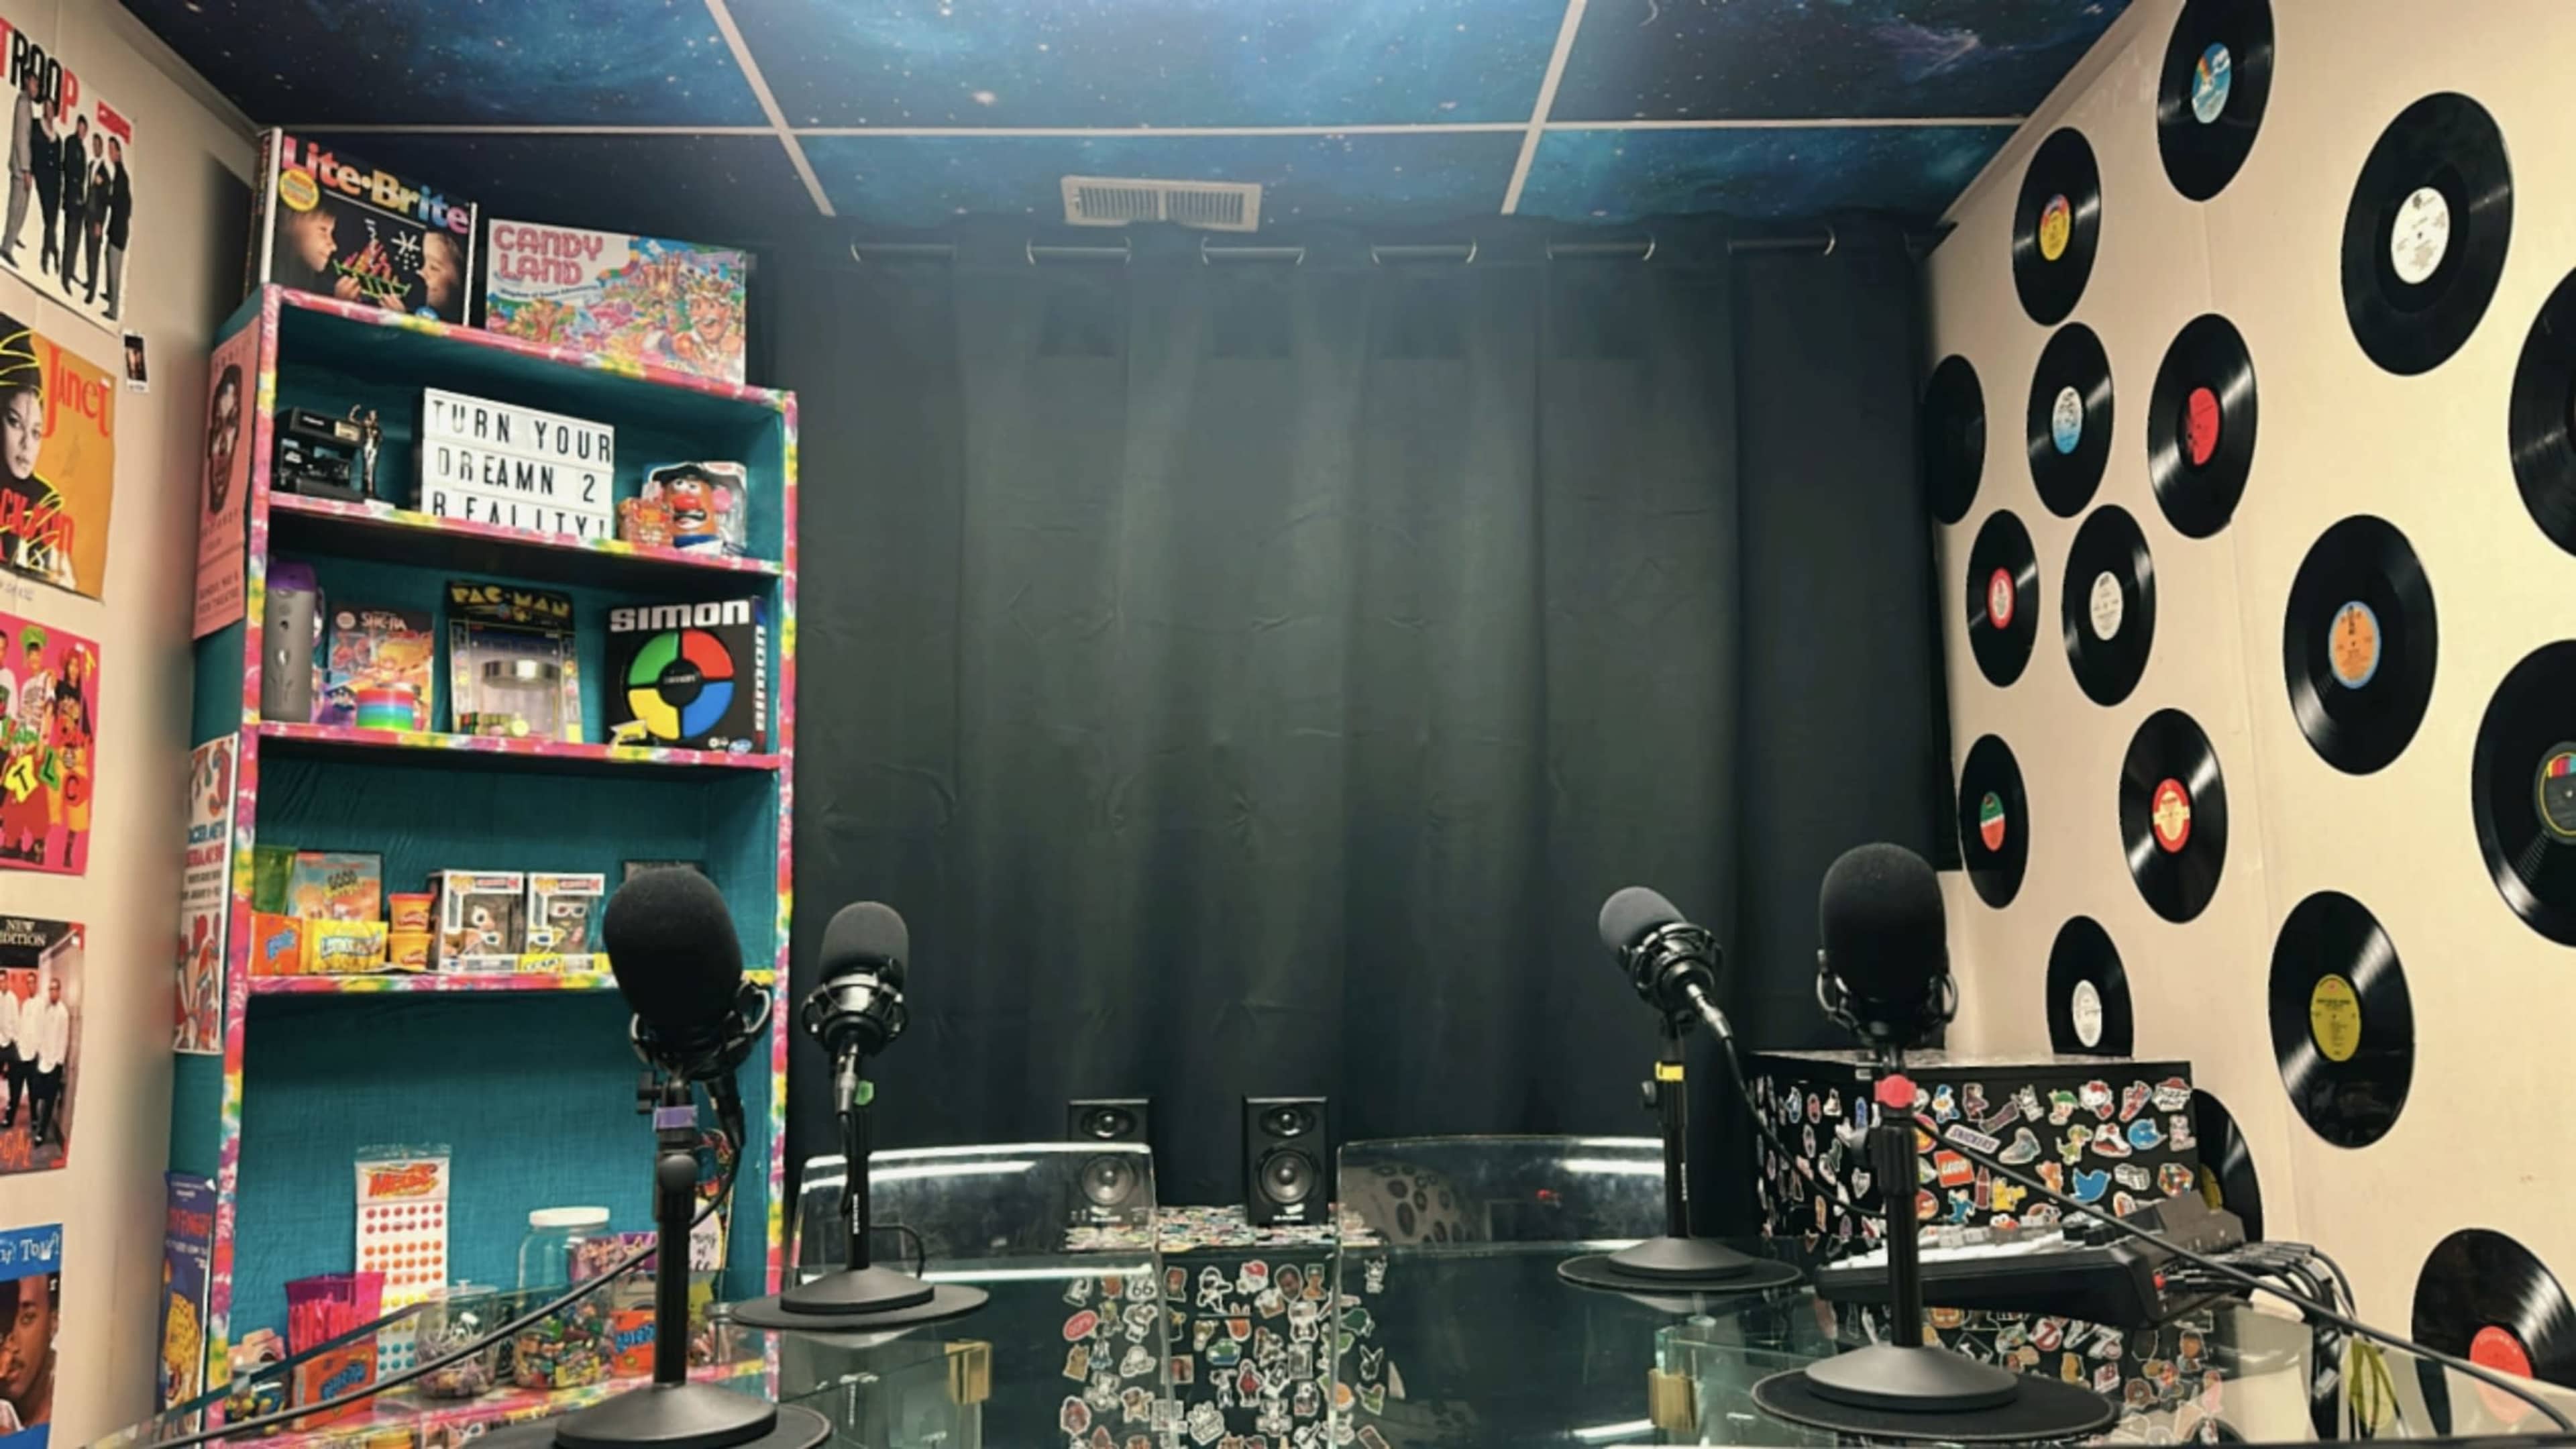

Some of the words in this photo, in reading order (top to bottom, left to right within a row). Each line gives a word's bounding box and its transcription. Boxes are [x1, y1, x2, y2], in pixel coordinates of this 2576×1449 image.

[494, 225, 603, 261] CANDY
[500, 250, 582, 285] LAND
[433, 400, 510, 443] TURN
[534, 419, 611, 463] YOUR
[437, 446, 553, 495] DREAMN
[582, 474, 596, 503] 2
